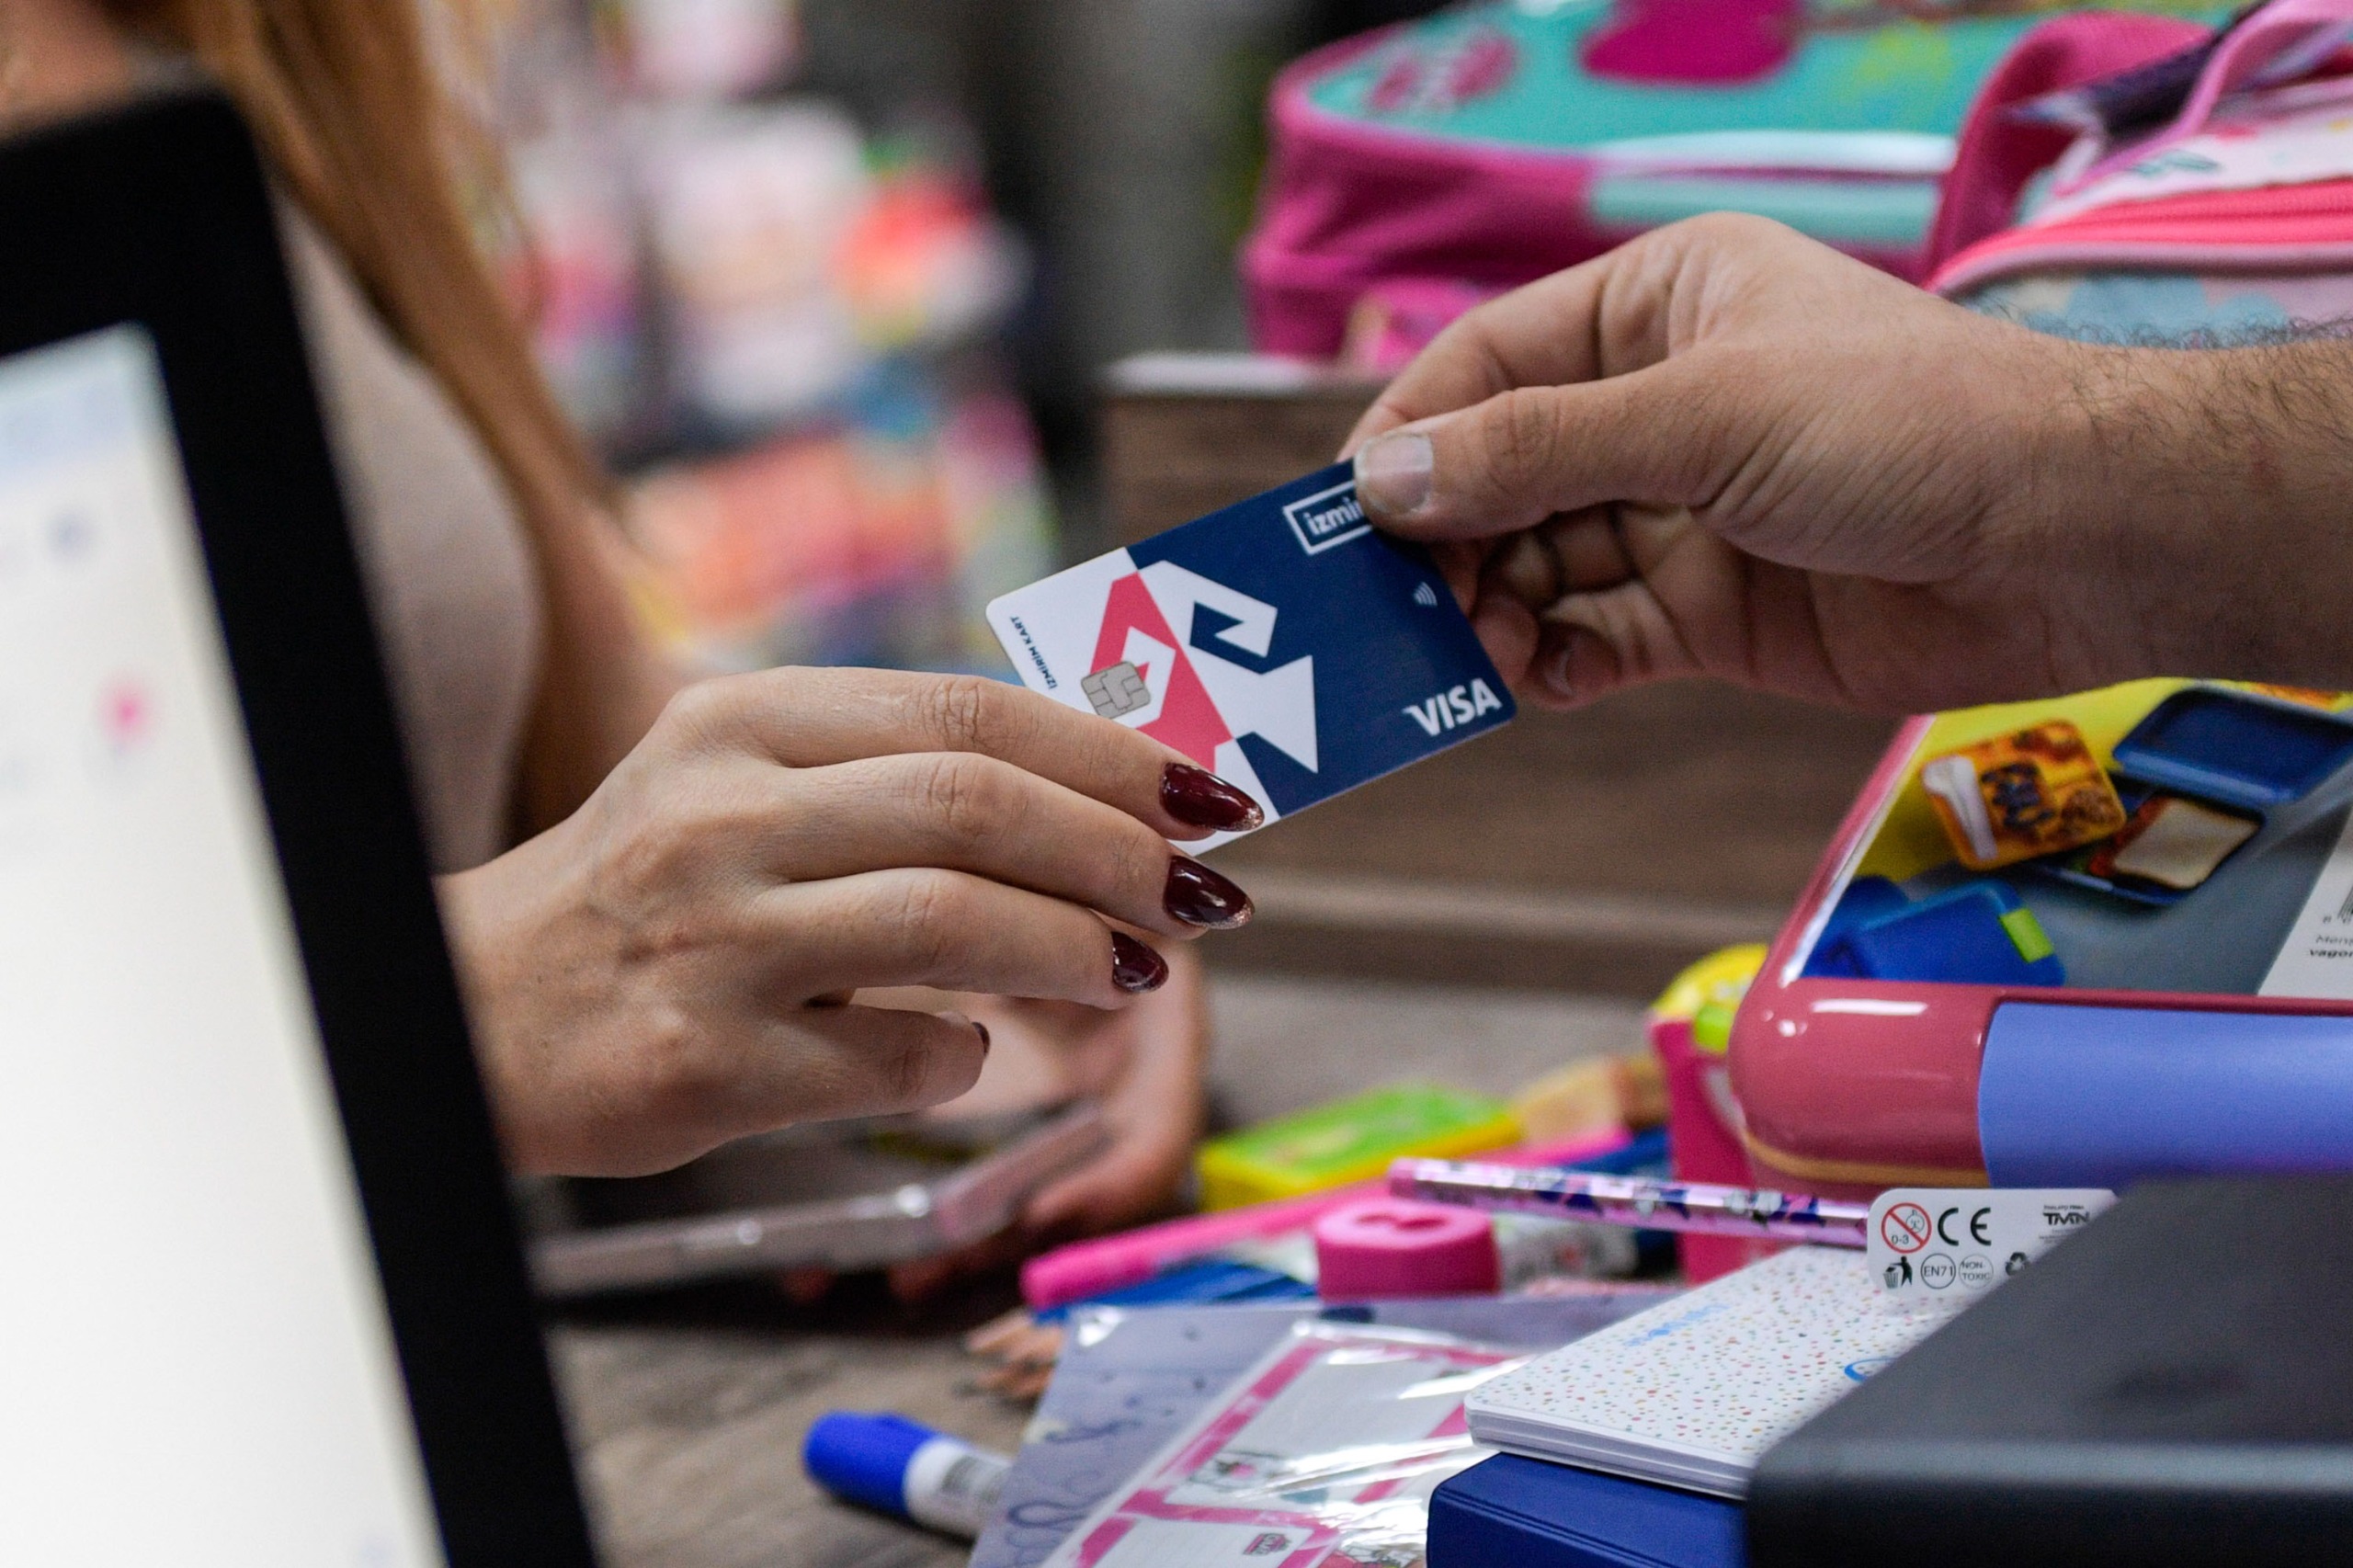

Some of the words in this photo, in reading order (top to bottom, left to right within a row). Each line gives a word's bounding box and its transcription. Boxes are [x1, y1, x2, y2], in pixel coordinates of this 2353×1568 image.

[1009, 616, 1032, 645] KART
[1402, 677, 1503, 736] VISA
[1938, 1207, 1992, 1246] CE
[1892, 1234, 1909, 1245] 0-3
[1924, 1266, 1954, 1277] EN71
[1962, 1273, 1991, 1281] TOXIC
